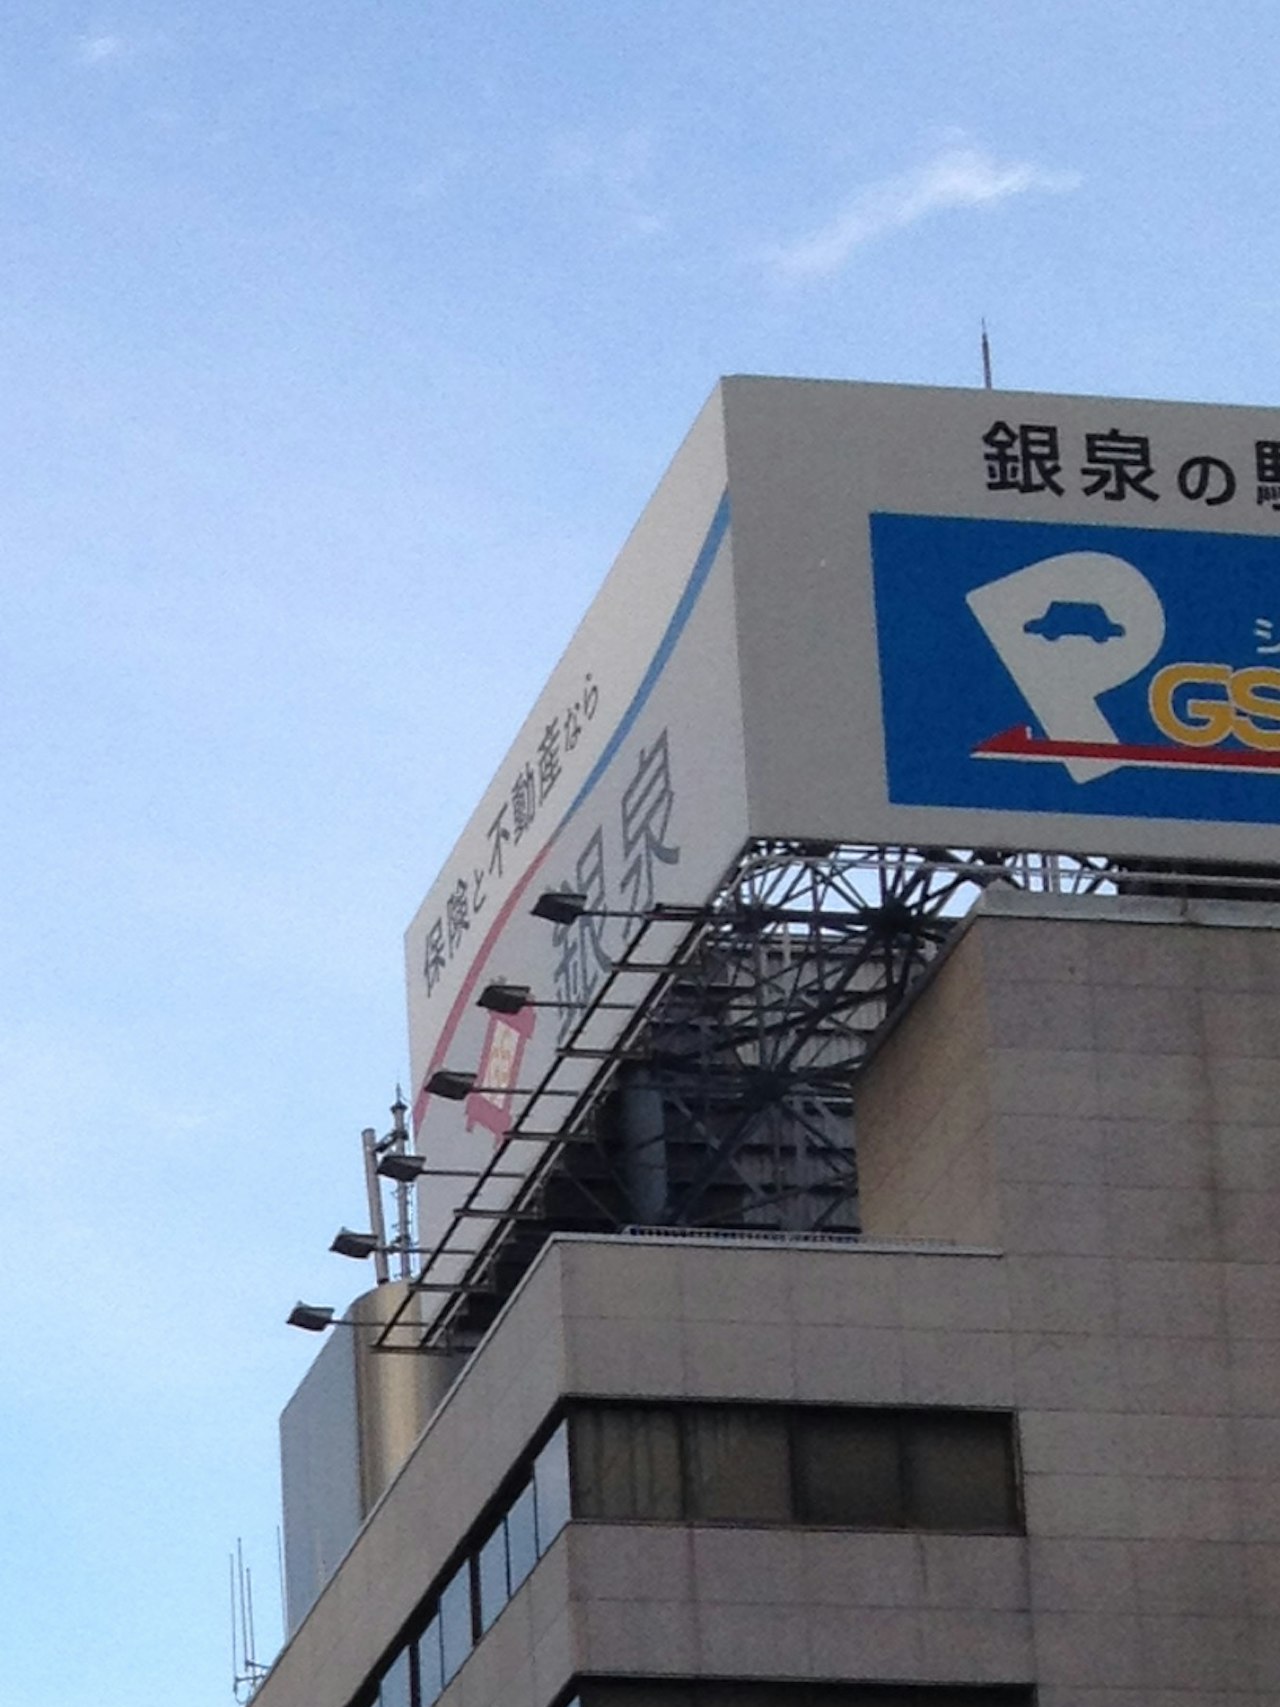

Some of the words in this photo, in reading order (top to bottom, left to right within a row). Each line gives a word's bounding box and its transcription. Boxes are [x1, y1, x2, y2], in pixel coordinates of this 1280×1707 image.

[423, 673, 600, 999] 保険と不動産なら
